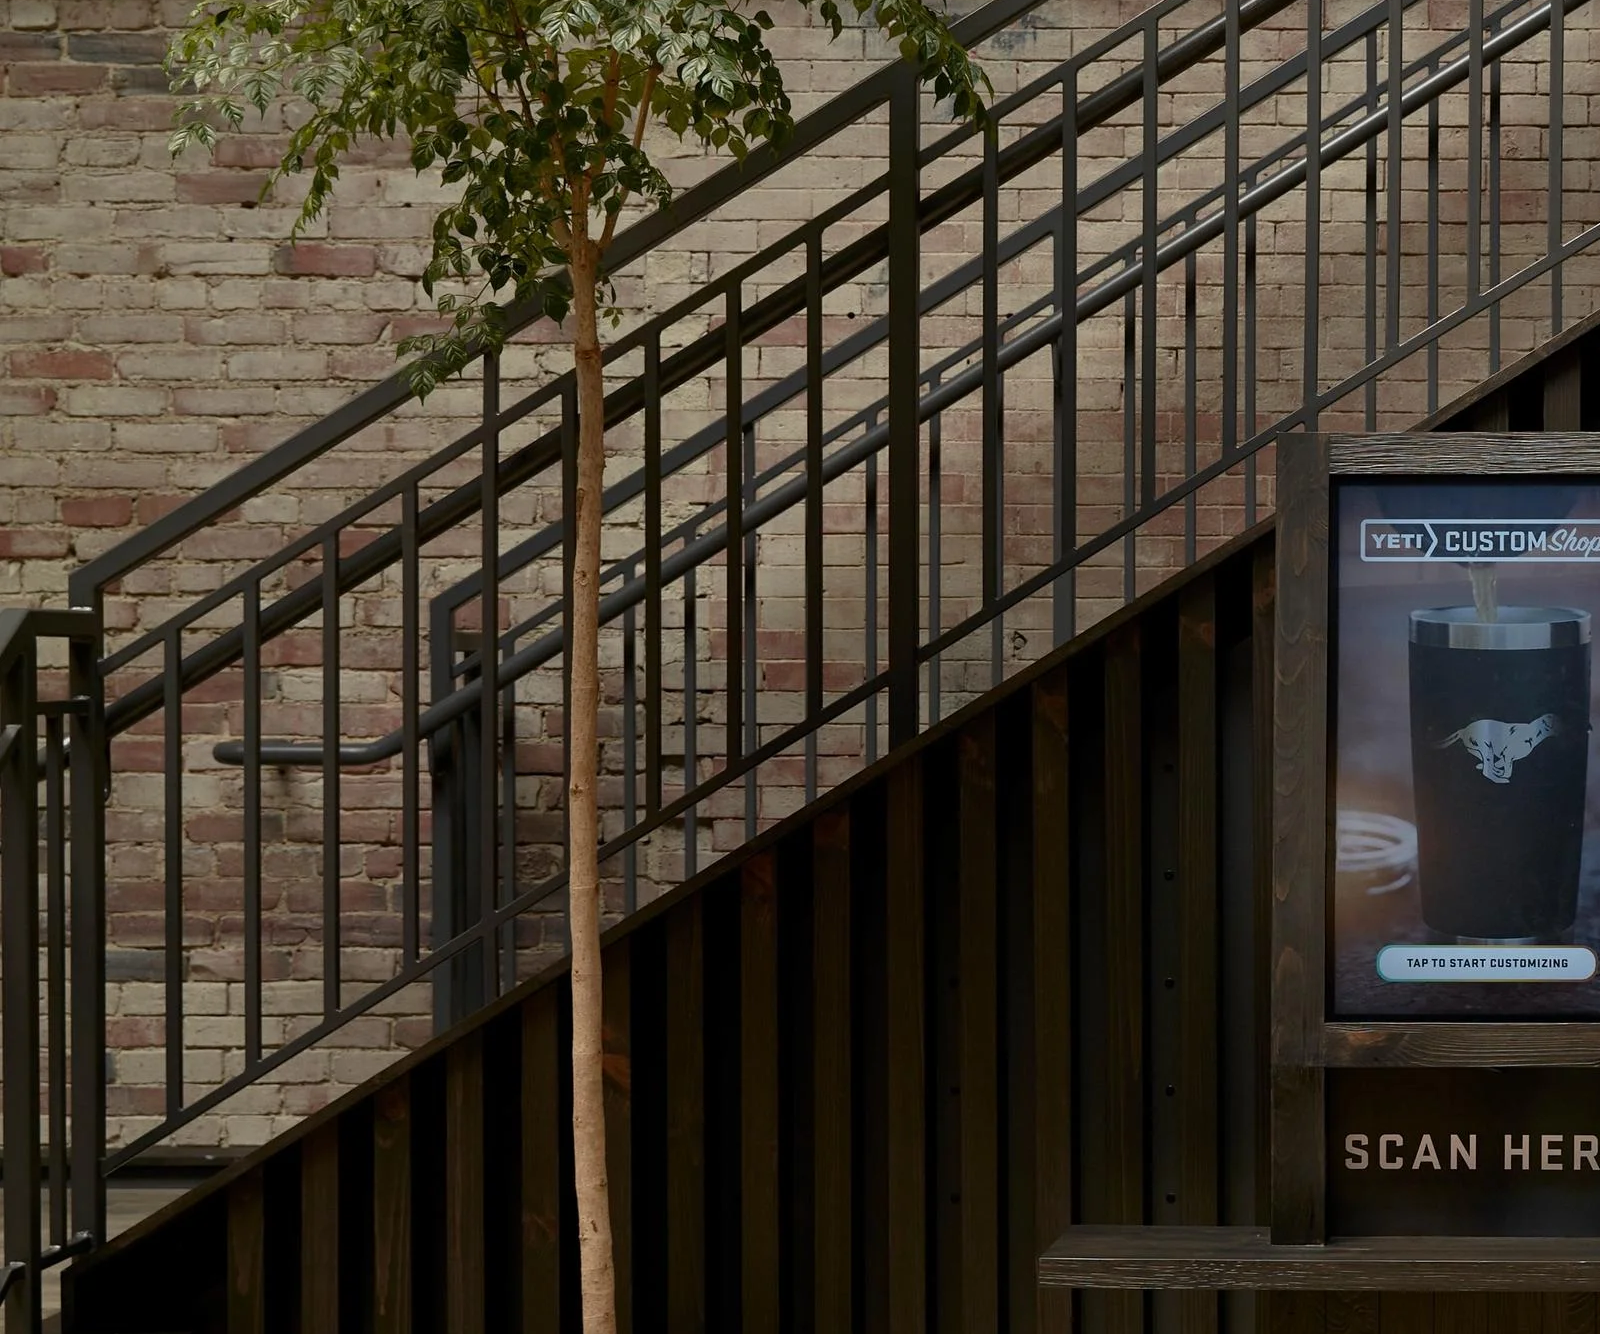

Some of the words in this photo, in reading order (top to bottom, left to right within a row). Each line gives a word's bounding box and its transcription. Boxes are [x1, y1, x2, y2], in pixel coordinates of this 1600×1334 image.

[1371, 533, 1424, 550] YETI
[1445, 530, 1549, 552] CUSTOM
[1407, 958, 1429, 968] TAP
[1431, 958, 1446, 968] TO
[1449, 958, 1487, 968] START
[1490, 958, 1569, 968] CUSTOMIZING
[1345, 1133, 1477, 1170] SCAN
